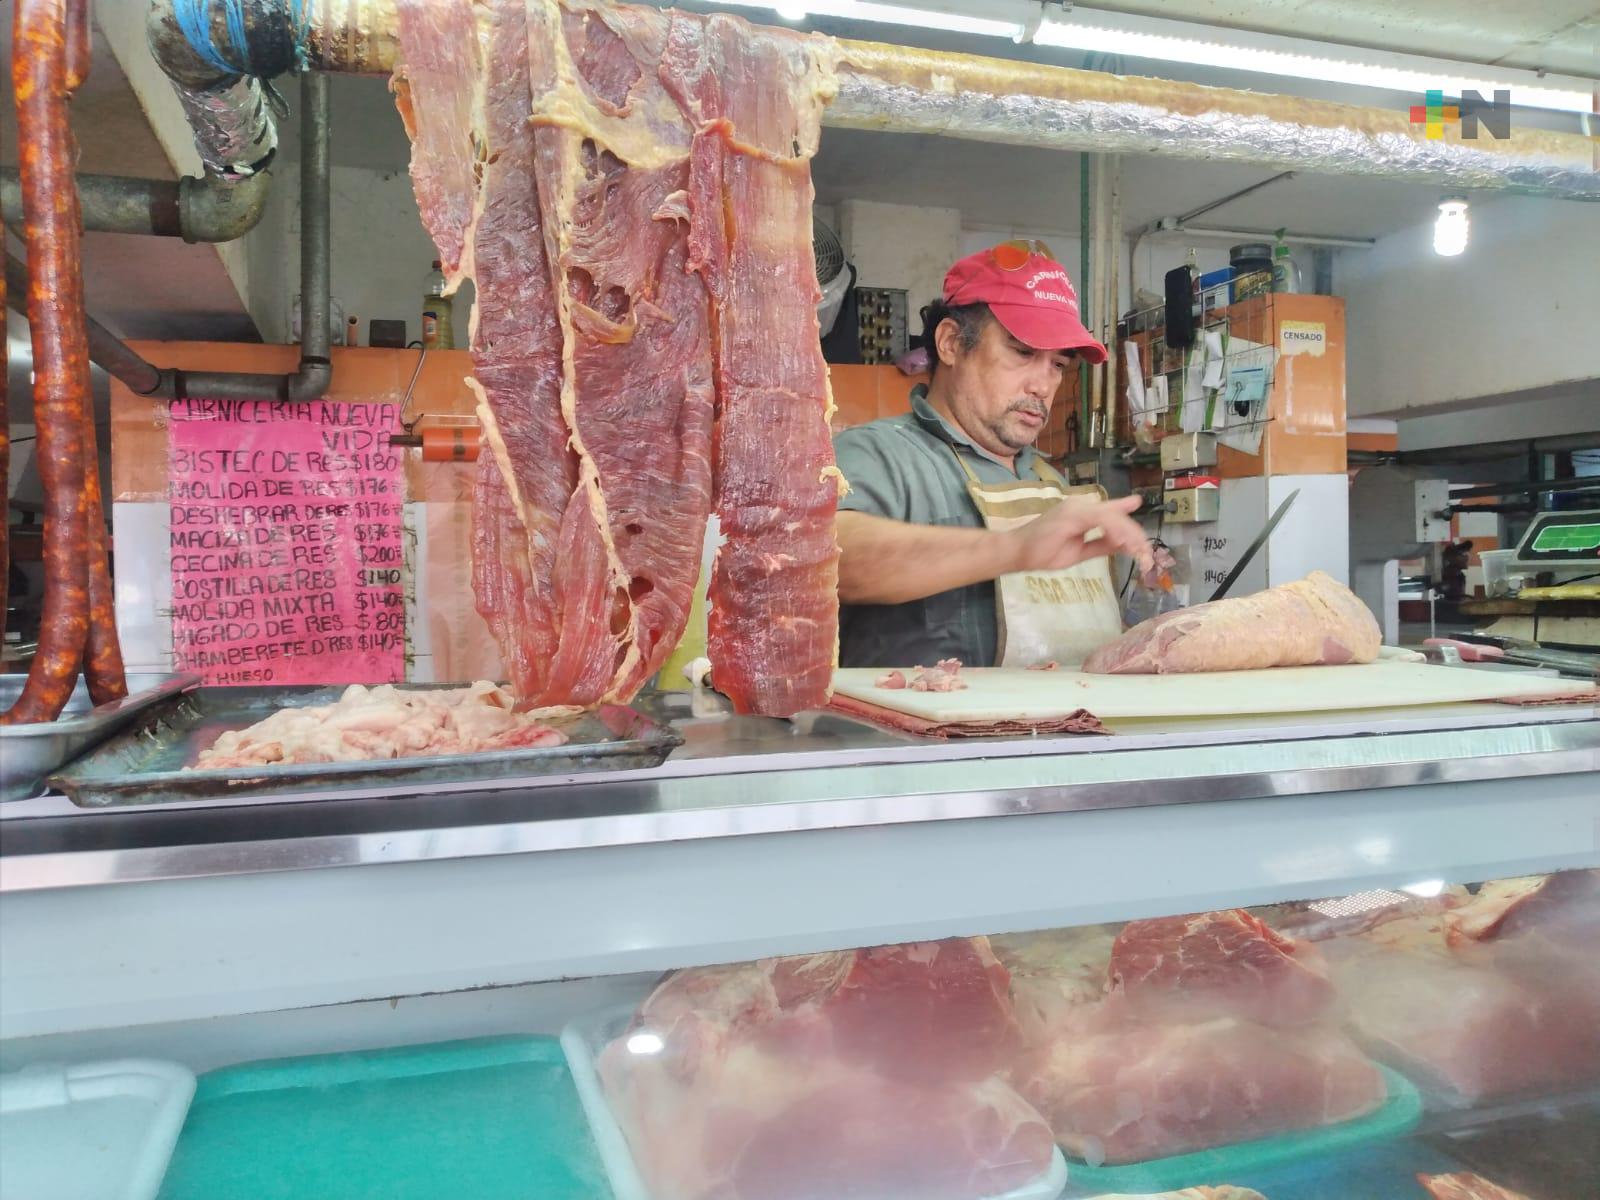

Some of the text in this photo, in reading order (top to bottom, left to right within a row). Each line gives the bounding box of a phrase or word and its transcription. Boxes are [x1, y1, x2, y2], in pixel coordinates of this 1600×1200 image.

[1034, 290, 1067, 303] NUEVA
[1283, 331, 1323, 342] CENSADO
[168, 399, 395, 428] CARNICERIA NUEVA
[322, 430, 392, 453] VIDA
[272, 450, 300, 473] DE
[306, 451, 348, 473] RES
[349, 452, 398, 474] $180
[169, 480, 259, 500] MOLIDA
[262, 479, 294, 497] DE
[302, 480, 341, 497] RES
[305, 504, 323, 520] DE
[170, 530, 250, 550] MACIZA
[255, 526, 290, 545] DE
[290, 523, 337, 543] RES
[170, 554, 253, 574] CECINA
[258, 550, 290, 568] DE
[291, 544, 337, 565] RES
[267, 573, 293, 595] DE
[294, 569, 337, 591] RES
[355, 569, 401, 588] $140
[171, 598, 255, 623] MOLIDA
[263, 591, 335, 617] MIXTA
[266, 618, 297, 639] DE
[305, 614, 344, 633] RES
[216, 669, 274, 685] HUESO
